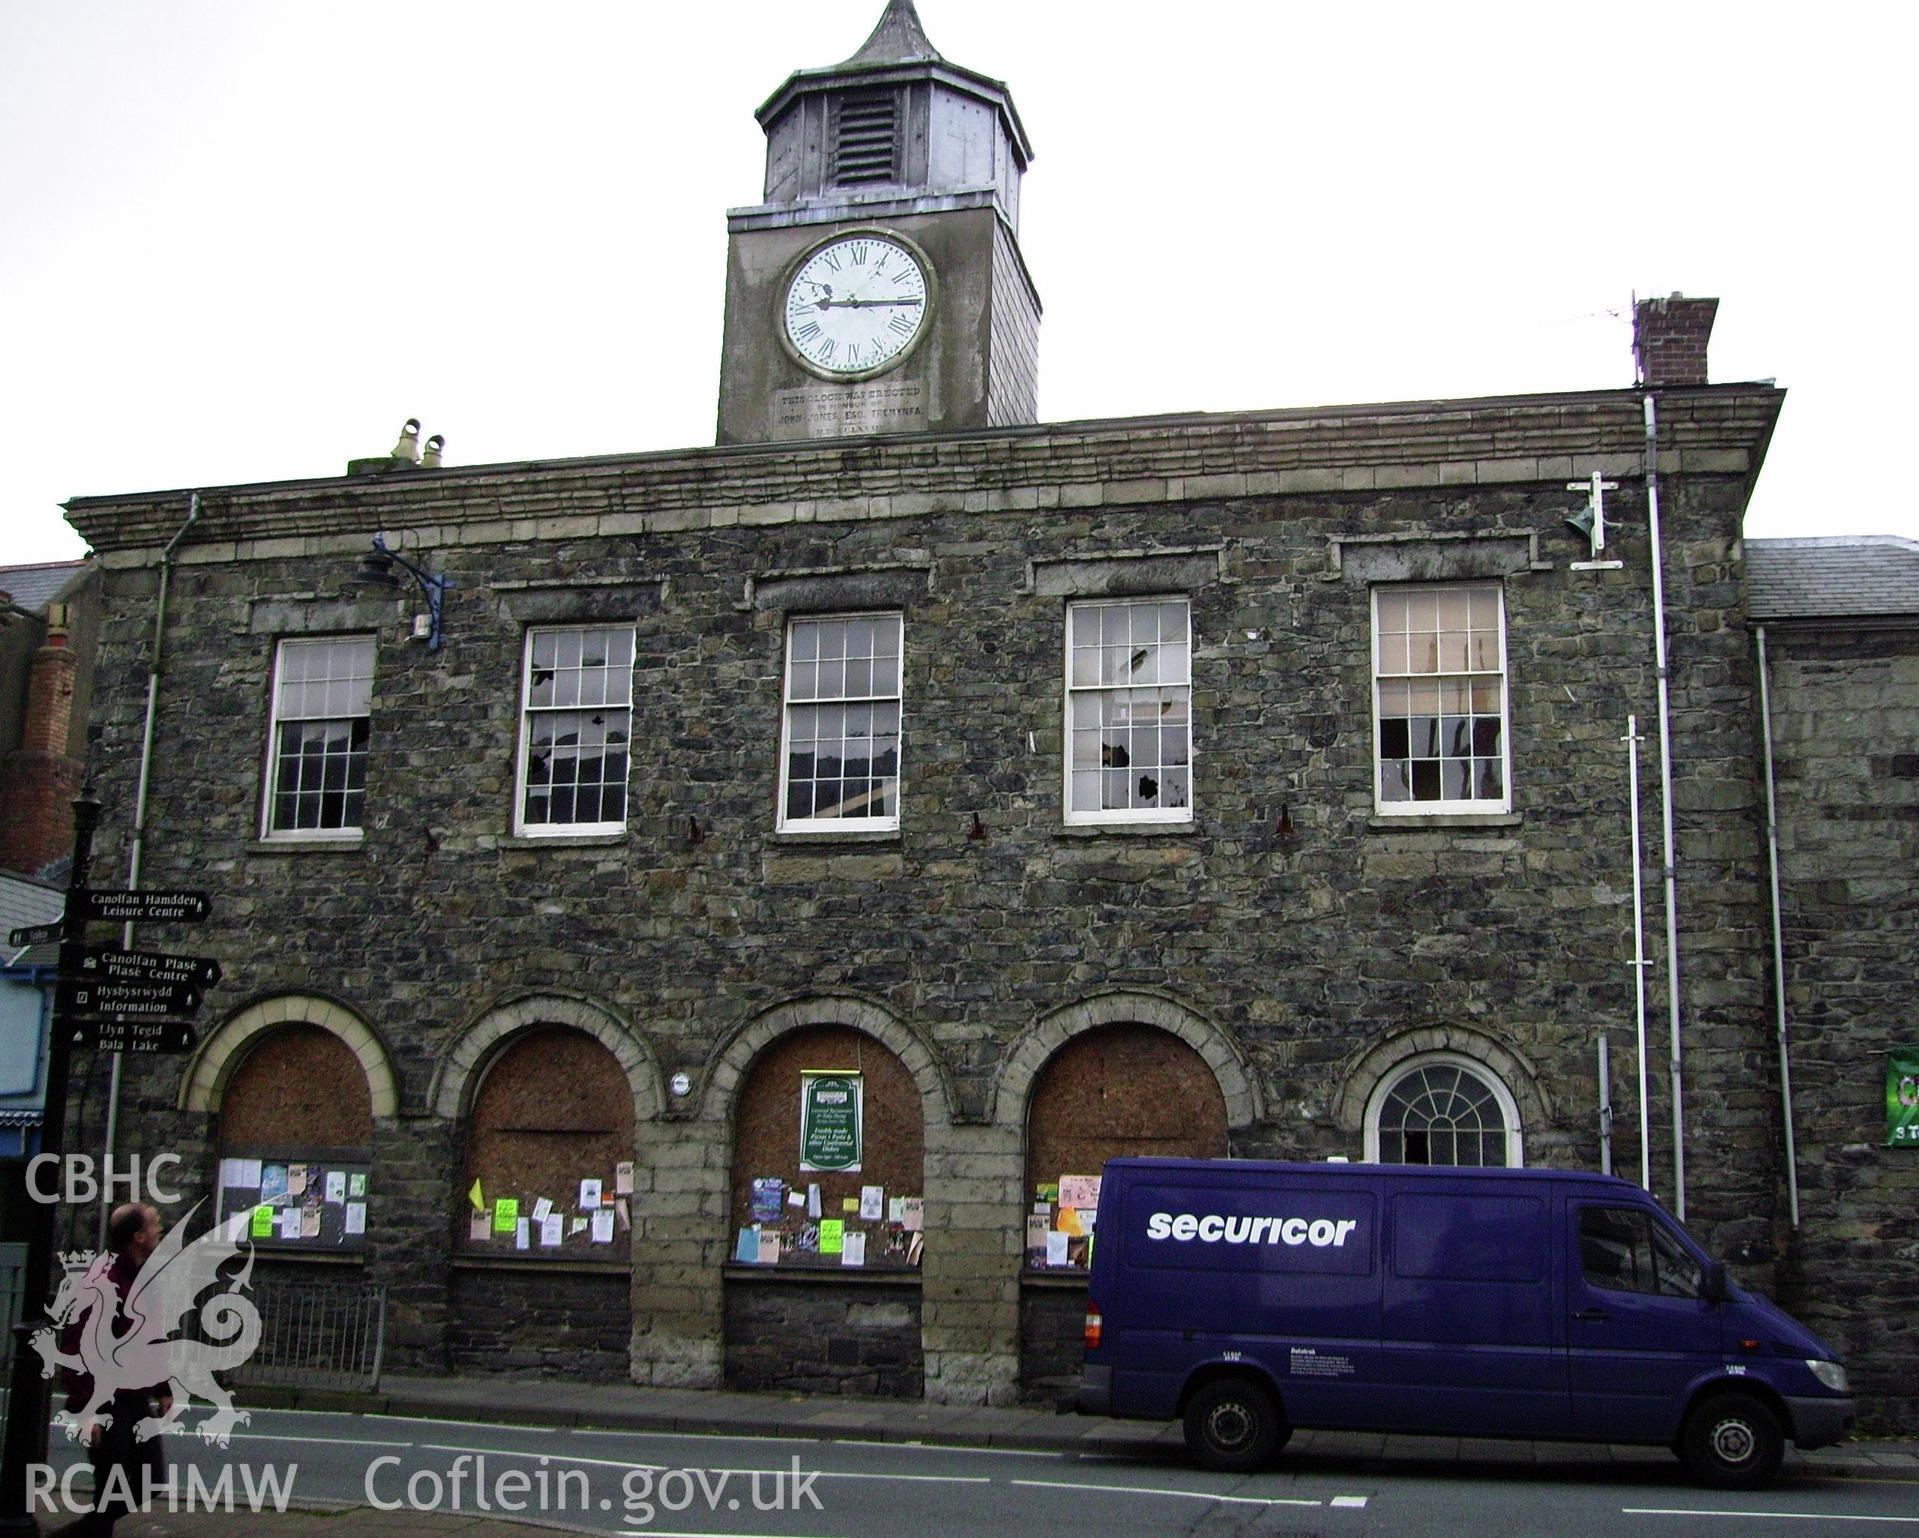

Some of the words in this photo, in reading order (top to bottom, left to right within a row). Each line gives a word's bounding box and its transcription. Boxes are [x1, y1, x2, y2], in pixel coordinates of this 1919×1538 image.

[808, 393, 842, 402] CLOCK
[845, 391, 866, 400] WAS
[868, 387, 921, 399] ERECTED
[91, 893, 140, 905] Canolfan
[145, 894, 197, 906] Hamdden
[103, 905, 144, 916] Leisure
[148, 906, 185, 917] Centre
[101, 952, 157, 967] Canolfan
[149, 969, 189, 981] Centre
[97, 986, 173, 999] Hysbysrwydd
[99, 1000, 168, 1013] Information
[99, 1024, 125, 1037] Llyn
[131, 1024, 163, 1038] Tegid
[99, 1039, 124, 1050] Bala
[132, 1040, 159, 1051] Lake
[1147, 1212, 1356, 1247] securicor
